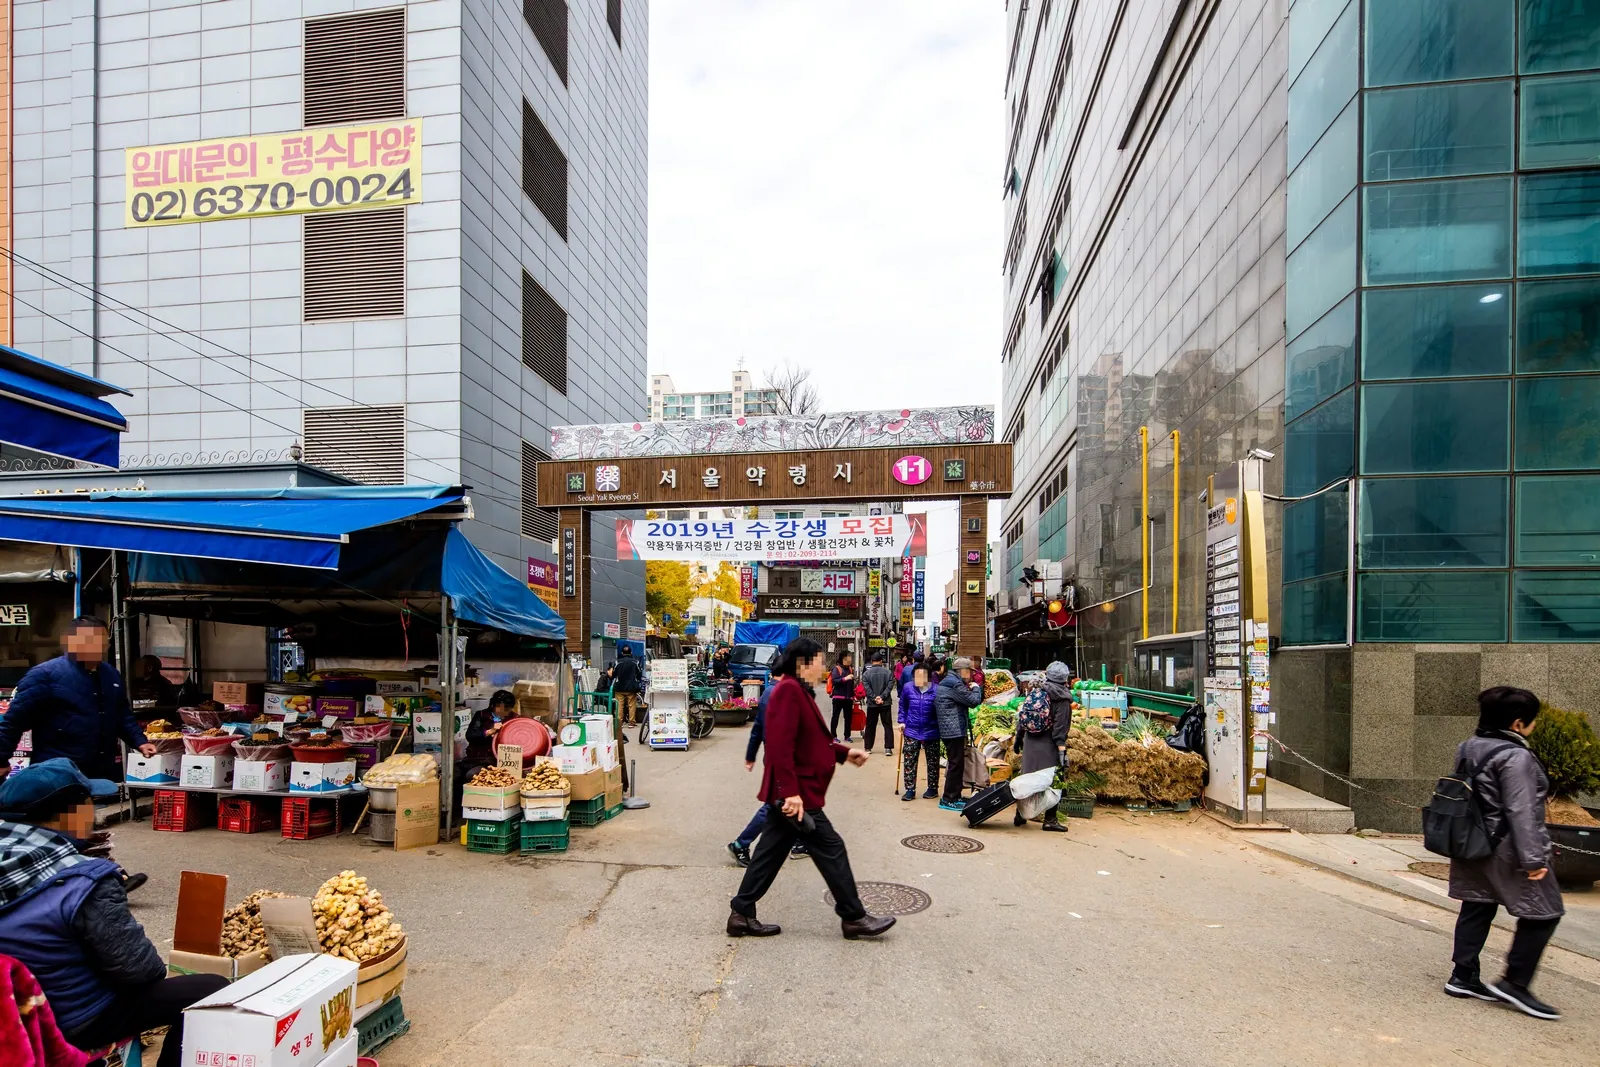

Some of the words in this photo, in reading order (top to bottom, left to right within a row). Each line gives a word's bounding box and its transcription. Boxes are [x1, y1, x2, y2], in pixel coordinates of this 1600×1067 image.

[132, 142, 257, 187] 임대문의
[281, 124, 416, 176] 평수다양
[896, 458, 926, 481] 1-1
[577, 494, 595, 502] Seoul
[608, 494, 631, 503] Ryeong
[632, 493, 639, 501] Si
[647, 521, 734, 539] 2019년
[746, 519, 827, 539] 수강생
[839, 516, 893, 536] 모집
[646, 540, 723, 552] 약용작물자격증반
[734, 540, 762, 551] 건강원
[766, 540, 796, 551] 창업반
[807, 537, 858, 550] 생활건강차
[861, 538, 870, 547] &
[874, 536, 895, 547] 꽃차
[787, 550, 837, 558] 02-2093-2114
[823, 573, 853, 591] 치과
[769, 599, 834, 609] 신중앙한의원
[290, 1032, 314, 1057] 생강
